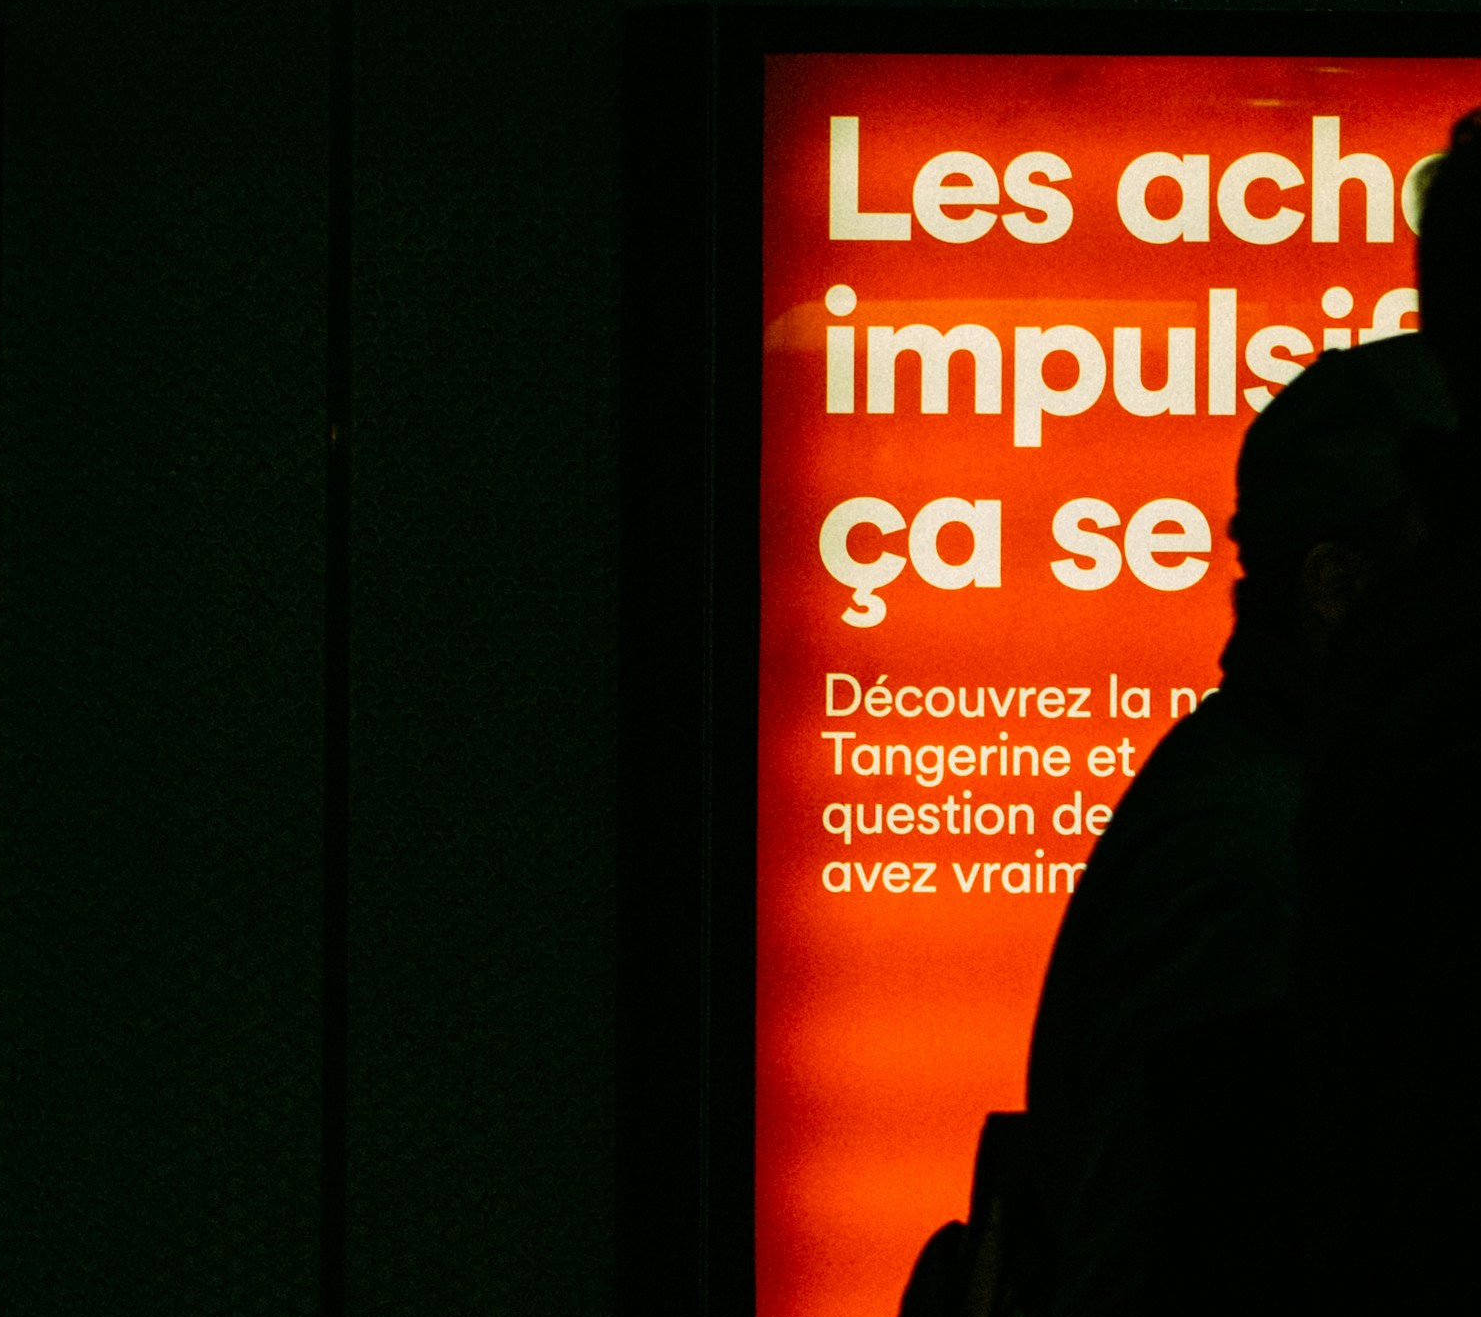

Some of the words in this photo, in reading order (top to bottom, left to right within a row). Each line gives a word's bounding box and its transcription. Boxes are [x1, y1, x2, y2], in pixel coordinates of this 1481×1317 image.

[828, 115, 1075, 245] Les
[818, 495, 1004, 630] ça
[1049, 495, 1213, 593] se
[824, 671, 1093, 719] Découvrez
[1108, 672, 1153, 720] la
[1169, 685, 1221, 719] n
[820, 730, 1072, 789] Tangerine
[1086, 736, 1137, 778] et
[821, 788, 1036, 845] question
[1051, 789, 1115, 837] de
[821, 860, 938, 894] avez
